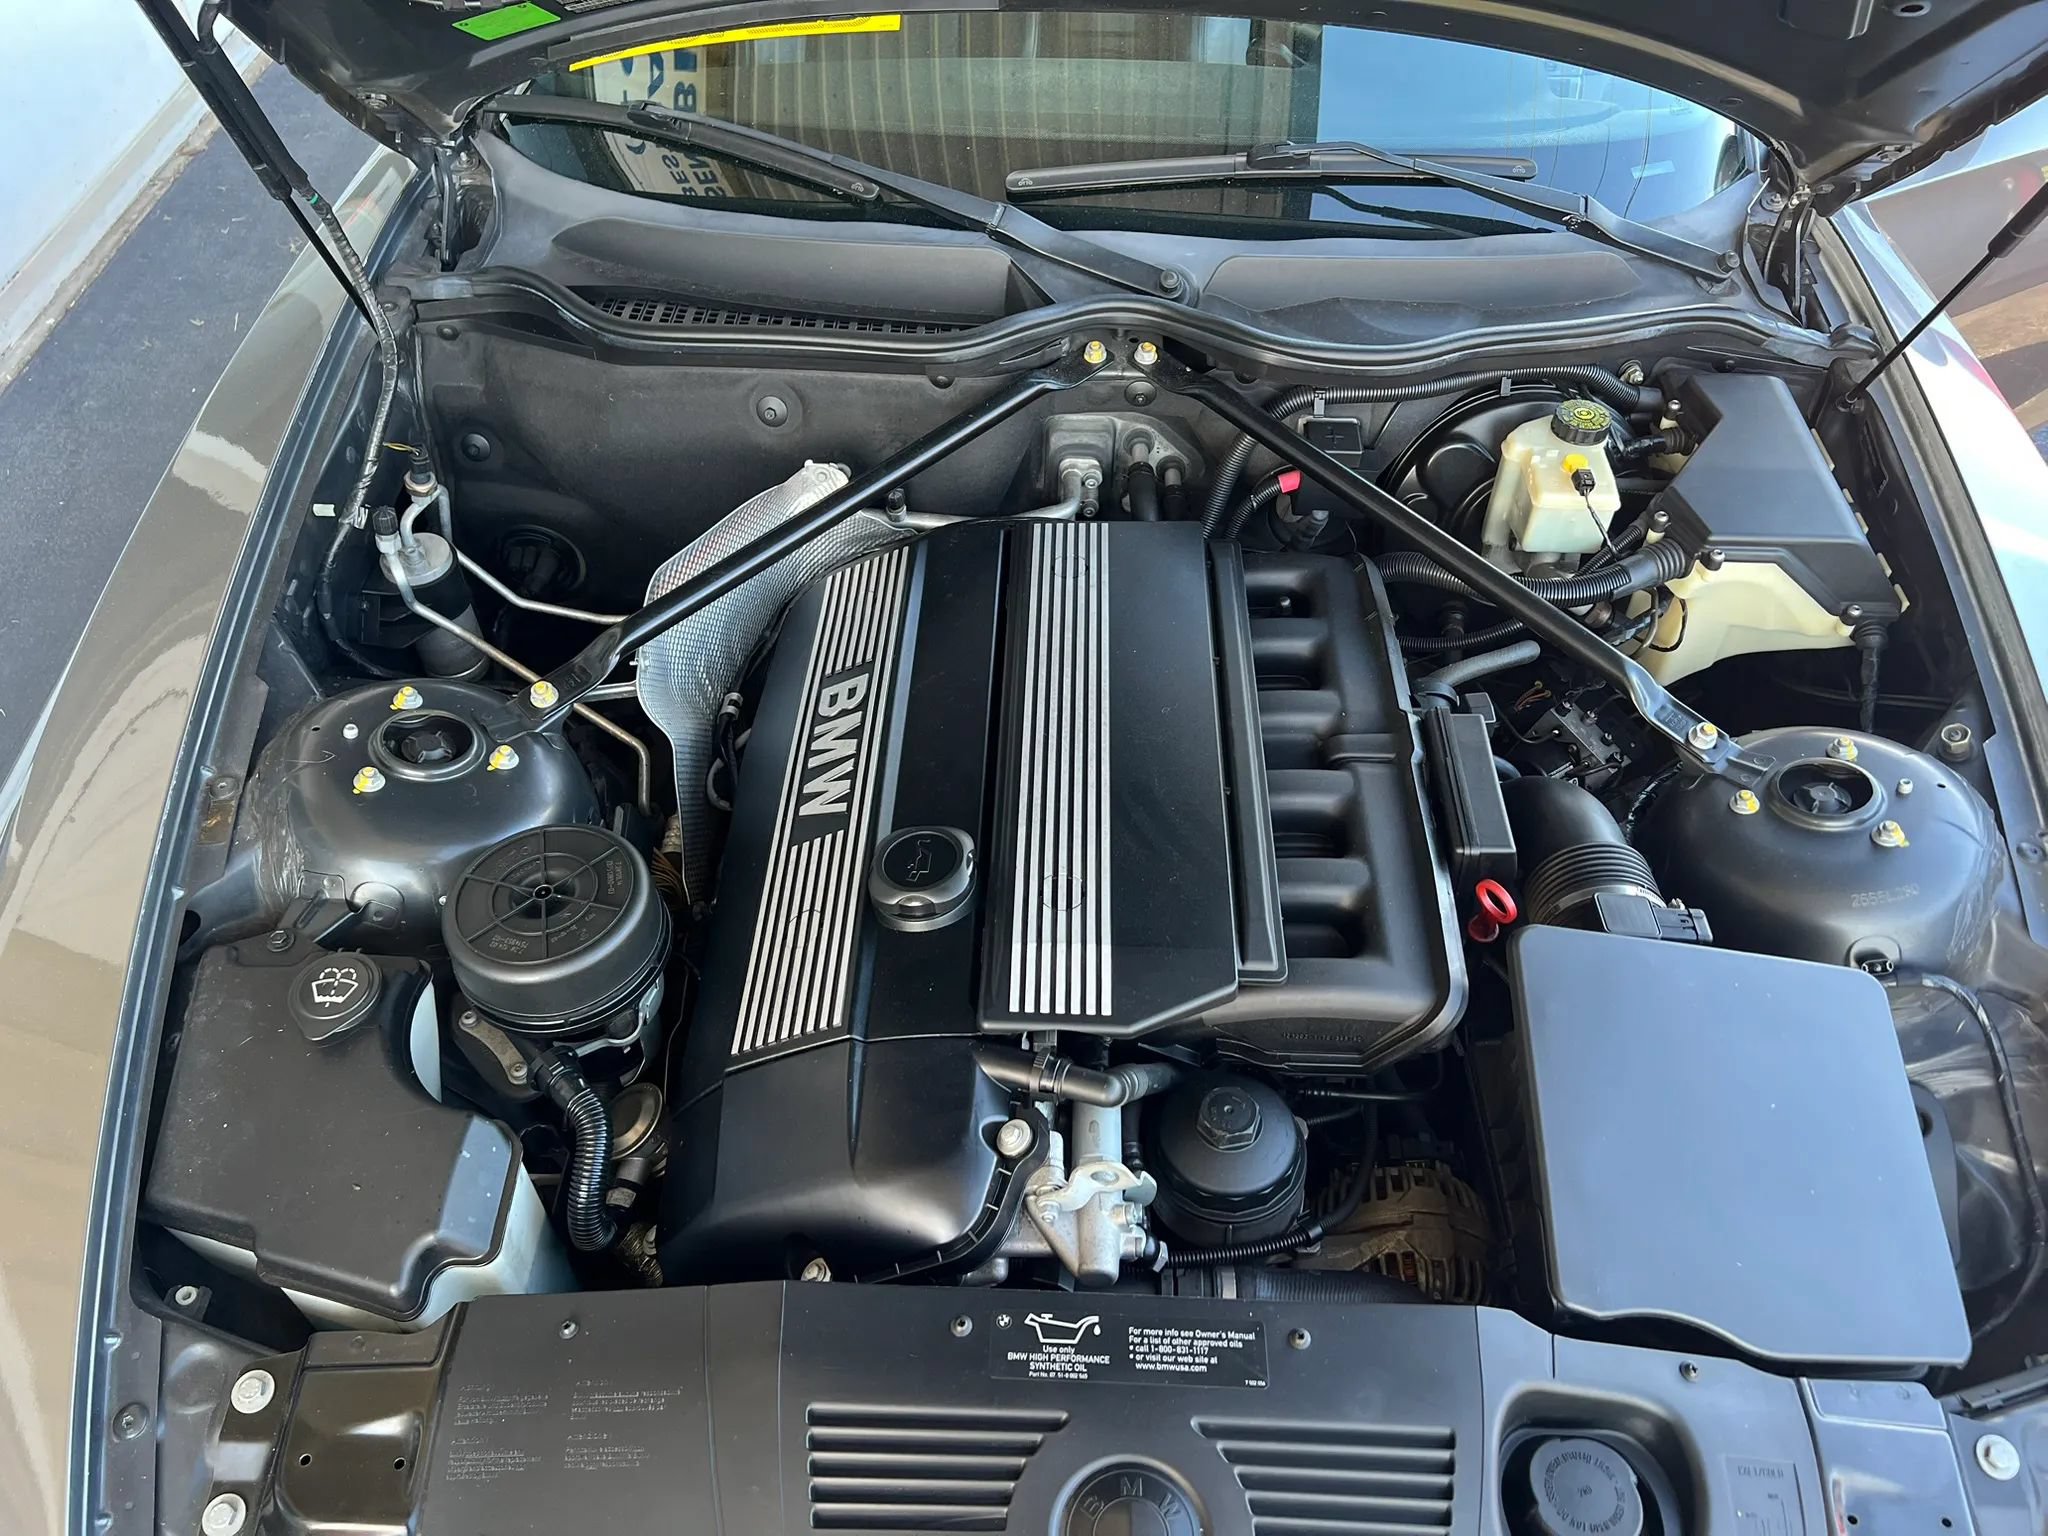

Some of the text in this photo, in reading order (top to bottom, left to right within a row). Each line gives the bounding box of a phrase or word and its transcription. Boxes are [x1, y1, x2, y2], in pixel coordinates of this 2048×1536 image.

[798, 672, 870, 817] BMW
[1129, 1326, 1142, 1335] For
[1165, 1328, 1179, 1337] info
[1195, 1329, 1227, 1339] Owner's
[1227, 1331, 1256, 1340] Manual
[1129, 1335, 1142, 1344] For
[1150, 1336, 1161, 1345] list
[1163, 1337, 1171, 1345] of
[1171, 1337, 1192, 1346] other
[1193, 1339, 1228, 1348] approved
[1229, 1339, 1243, 1348] oils
[1042, 1344, 1075, 1355] Use only
[1135, 1345, 1149, 1353] call
[1007, 1351, 1111, 1365] BMW HIGH PERFORMANCE
[1145, 1353, 1161, 1362] visit
[1177, 1355, 1193, 1363] web
[1195, 1355, 1209, 1364] site
[1210, 1356, 1218, 1365] at
[1029, 1361, 1088, 1372] SYNTHETIC OIL
[1135, 1362, 1208, 1373] www.bmwusa.com
[1080, 1475, 1181, 1522] BMW
